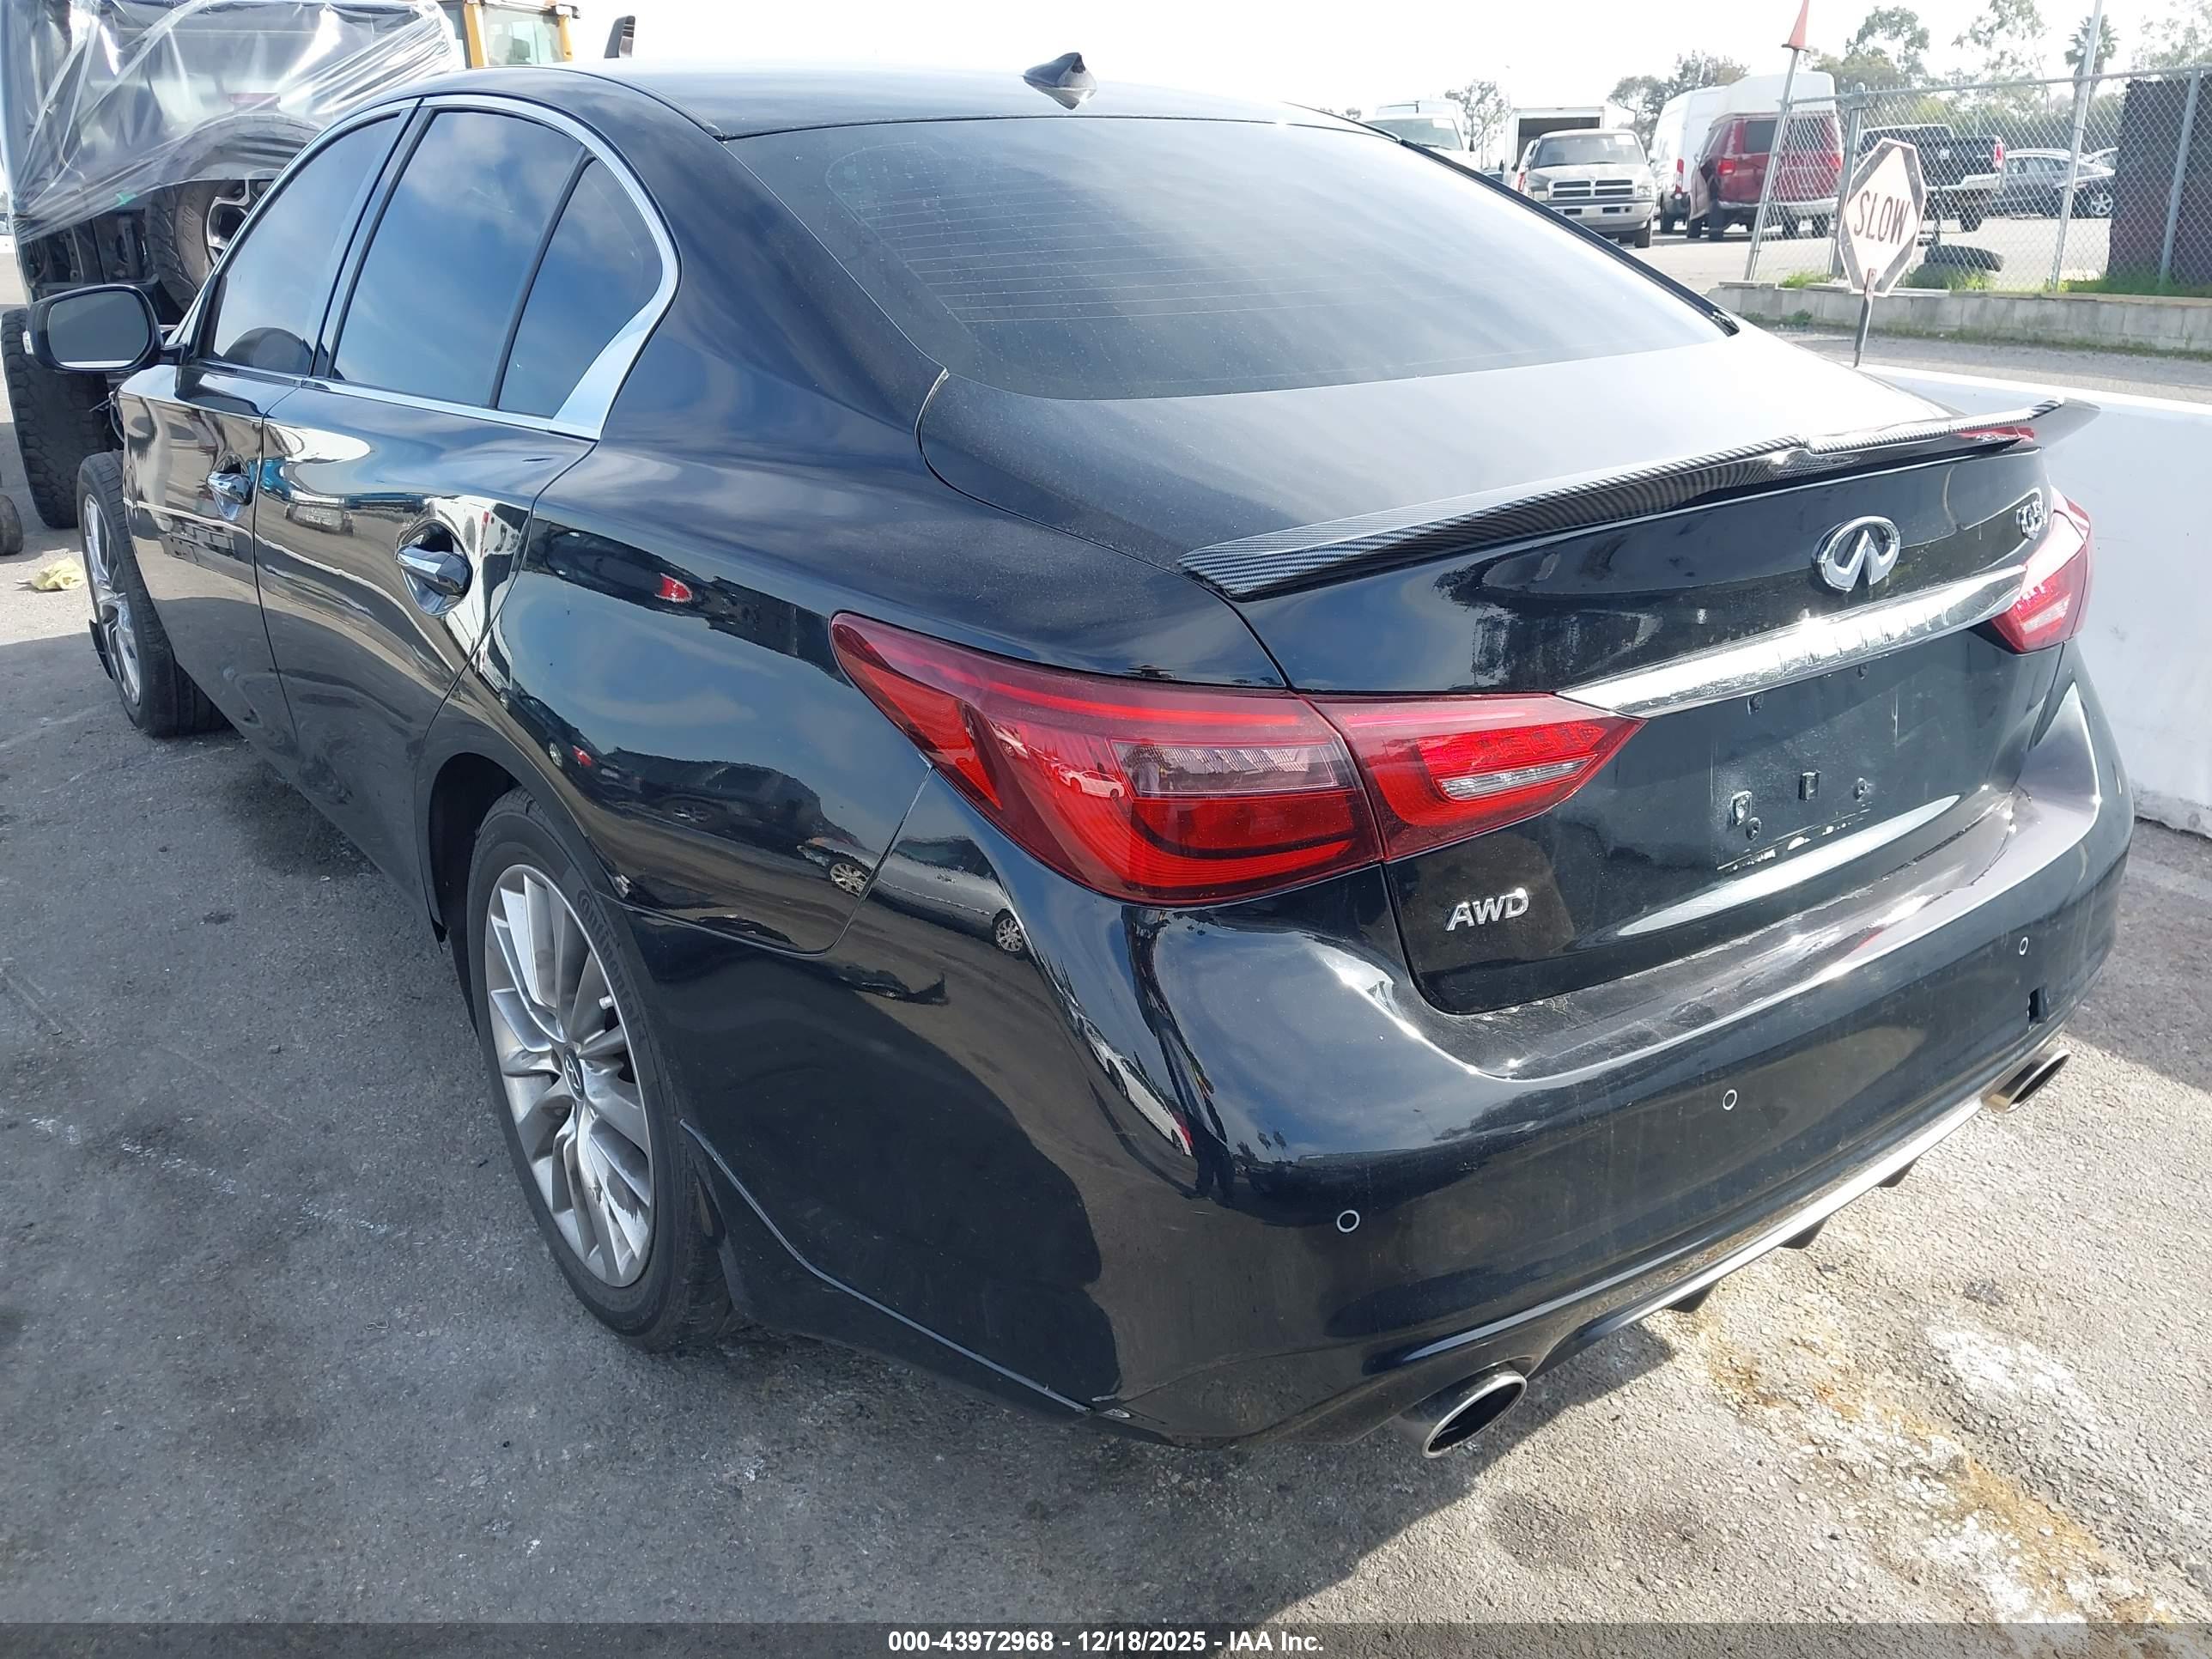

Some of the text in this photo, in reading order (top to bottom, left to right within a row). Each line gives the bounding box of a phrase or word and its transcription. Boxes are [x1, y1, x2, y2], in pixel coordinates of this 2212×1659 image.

[1853, 190, 1911, 246] SLOW
[1445, 887, 1528, 931] AWD
[577, 888, 641, 1026] Continental
